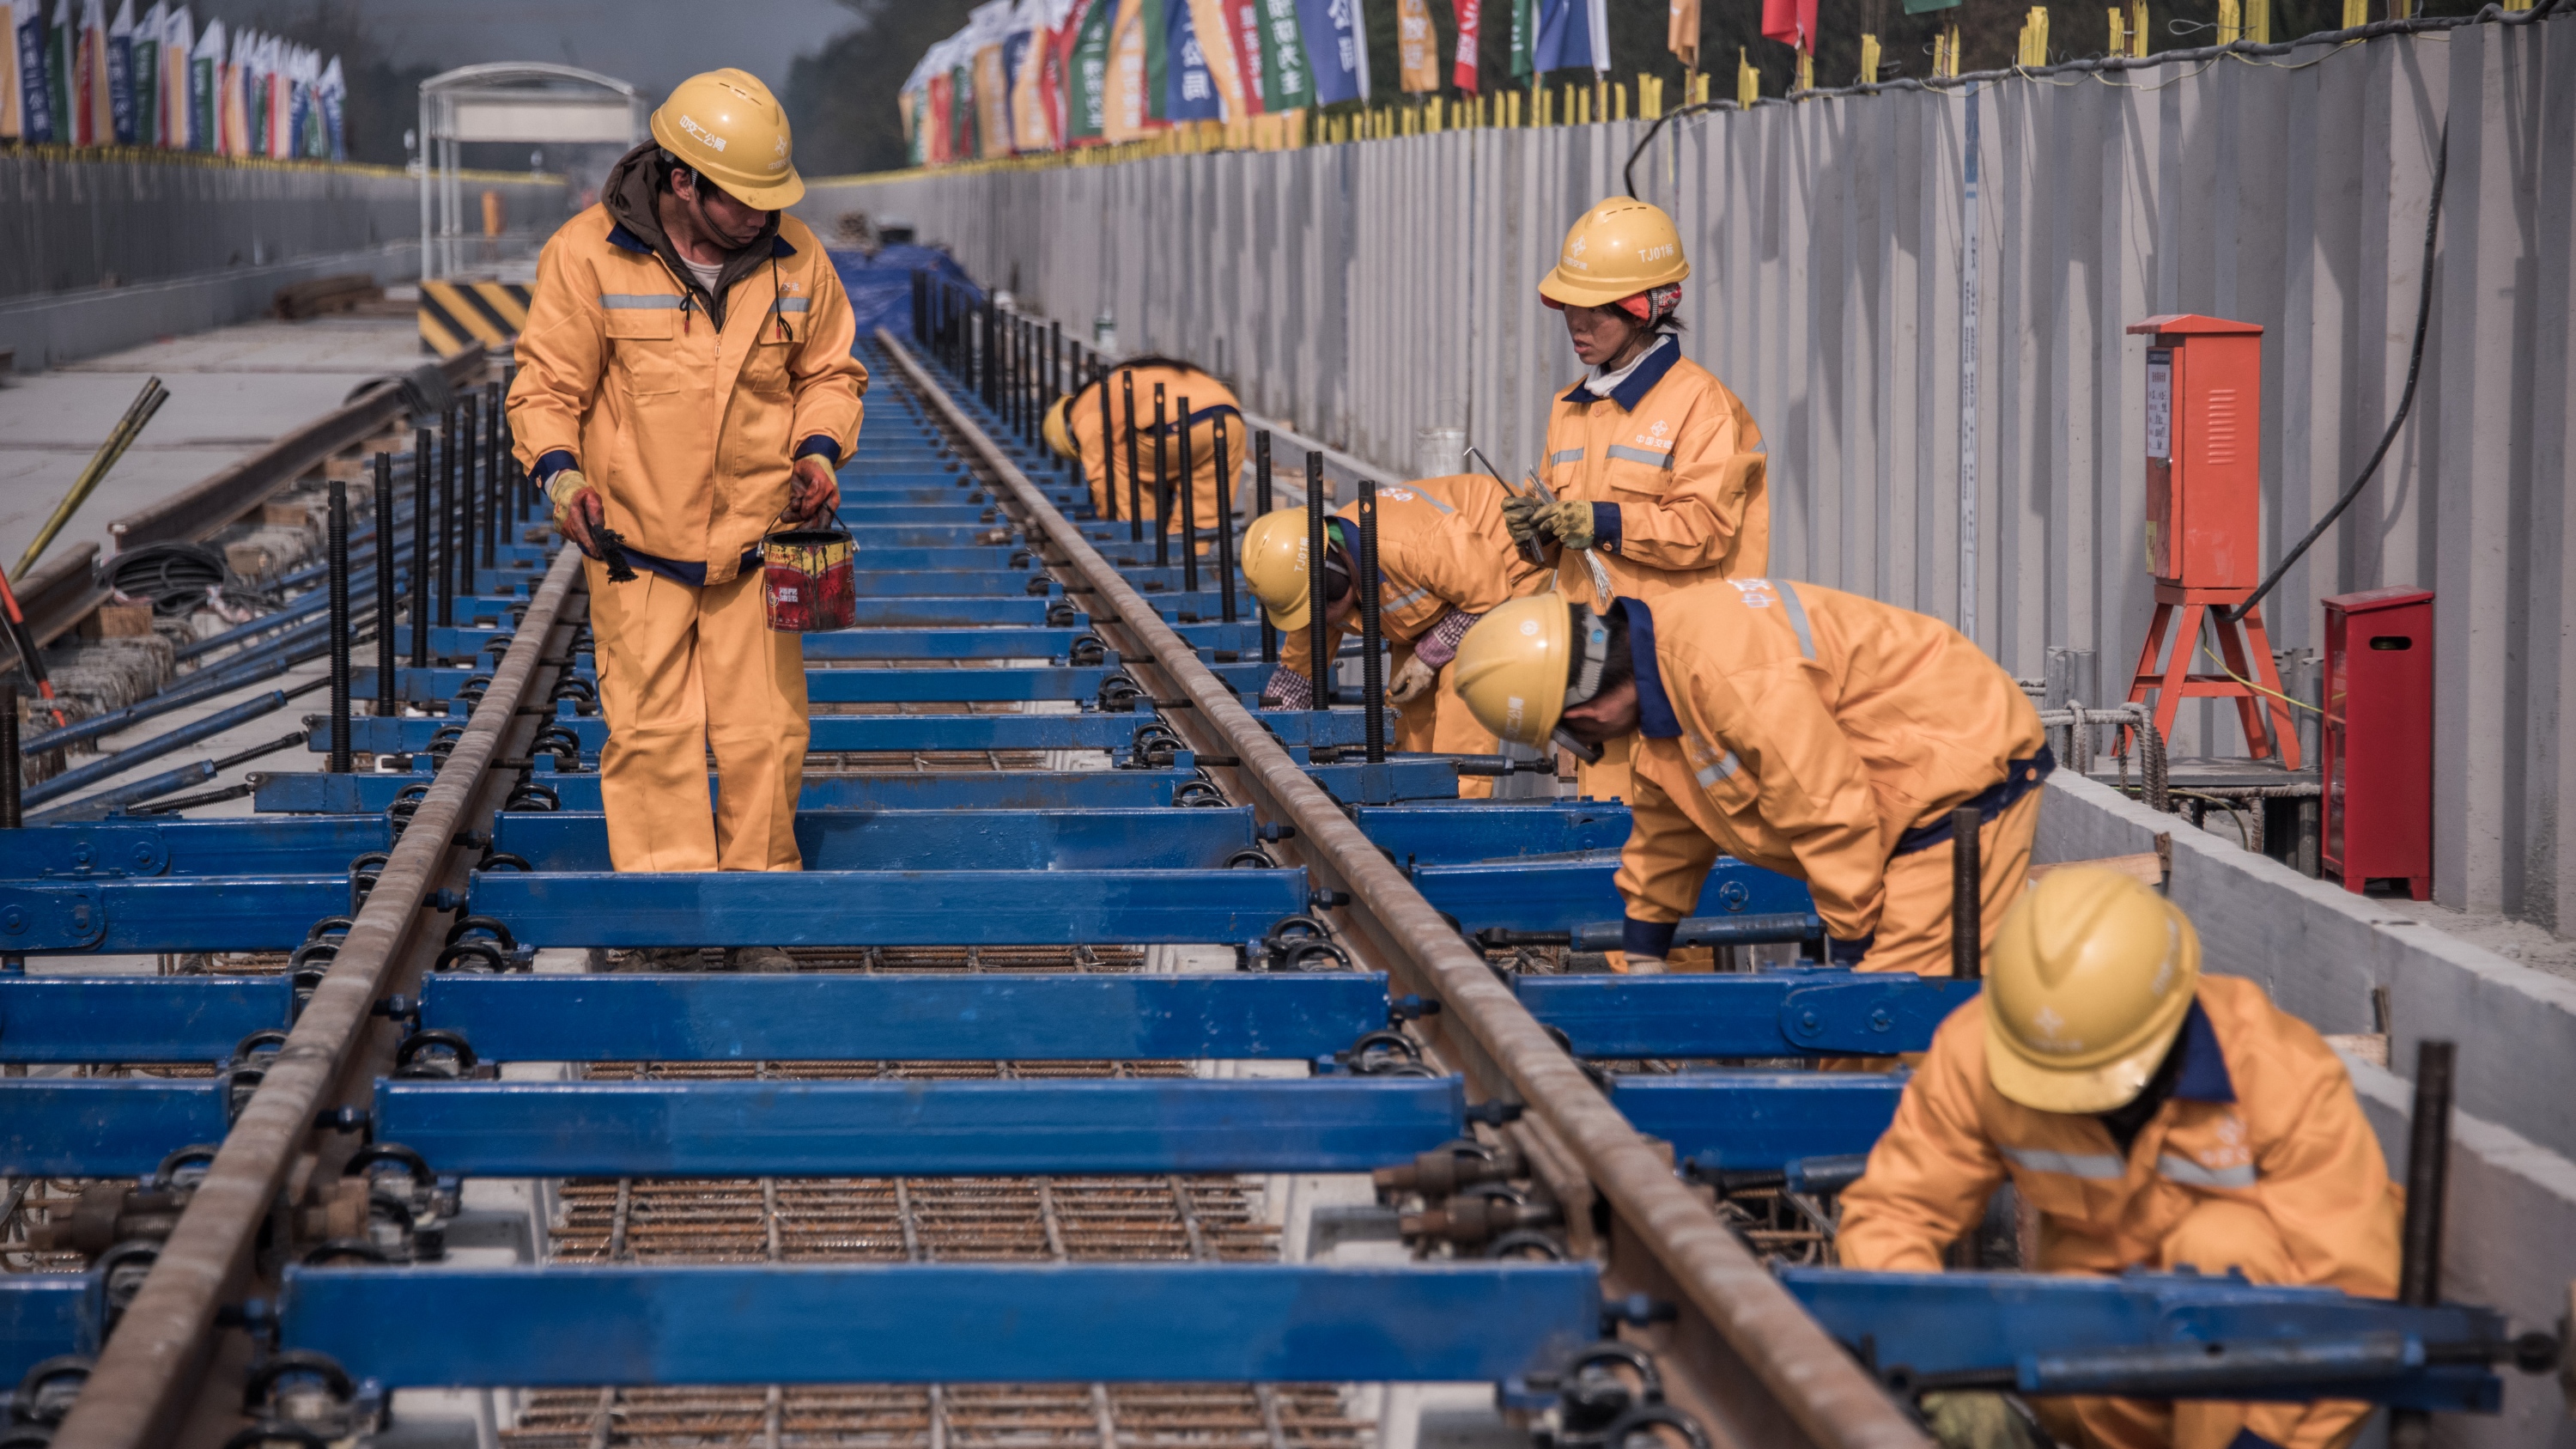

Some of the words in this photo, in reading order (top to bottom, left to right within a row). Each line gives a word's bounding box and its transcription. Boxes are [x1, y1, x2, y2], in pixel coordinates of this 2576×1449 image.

[679, 114, 727, 152] 中交二公局
[1637, 243, 1674, 263] TJ01标
[1636, 434, 1673, 449] 中国交建
